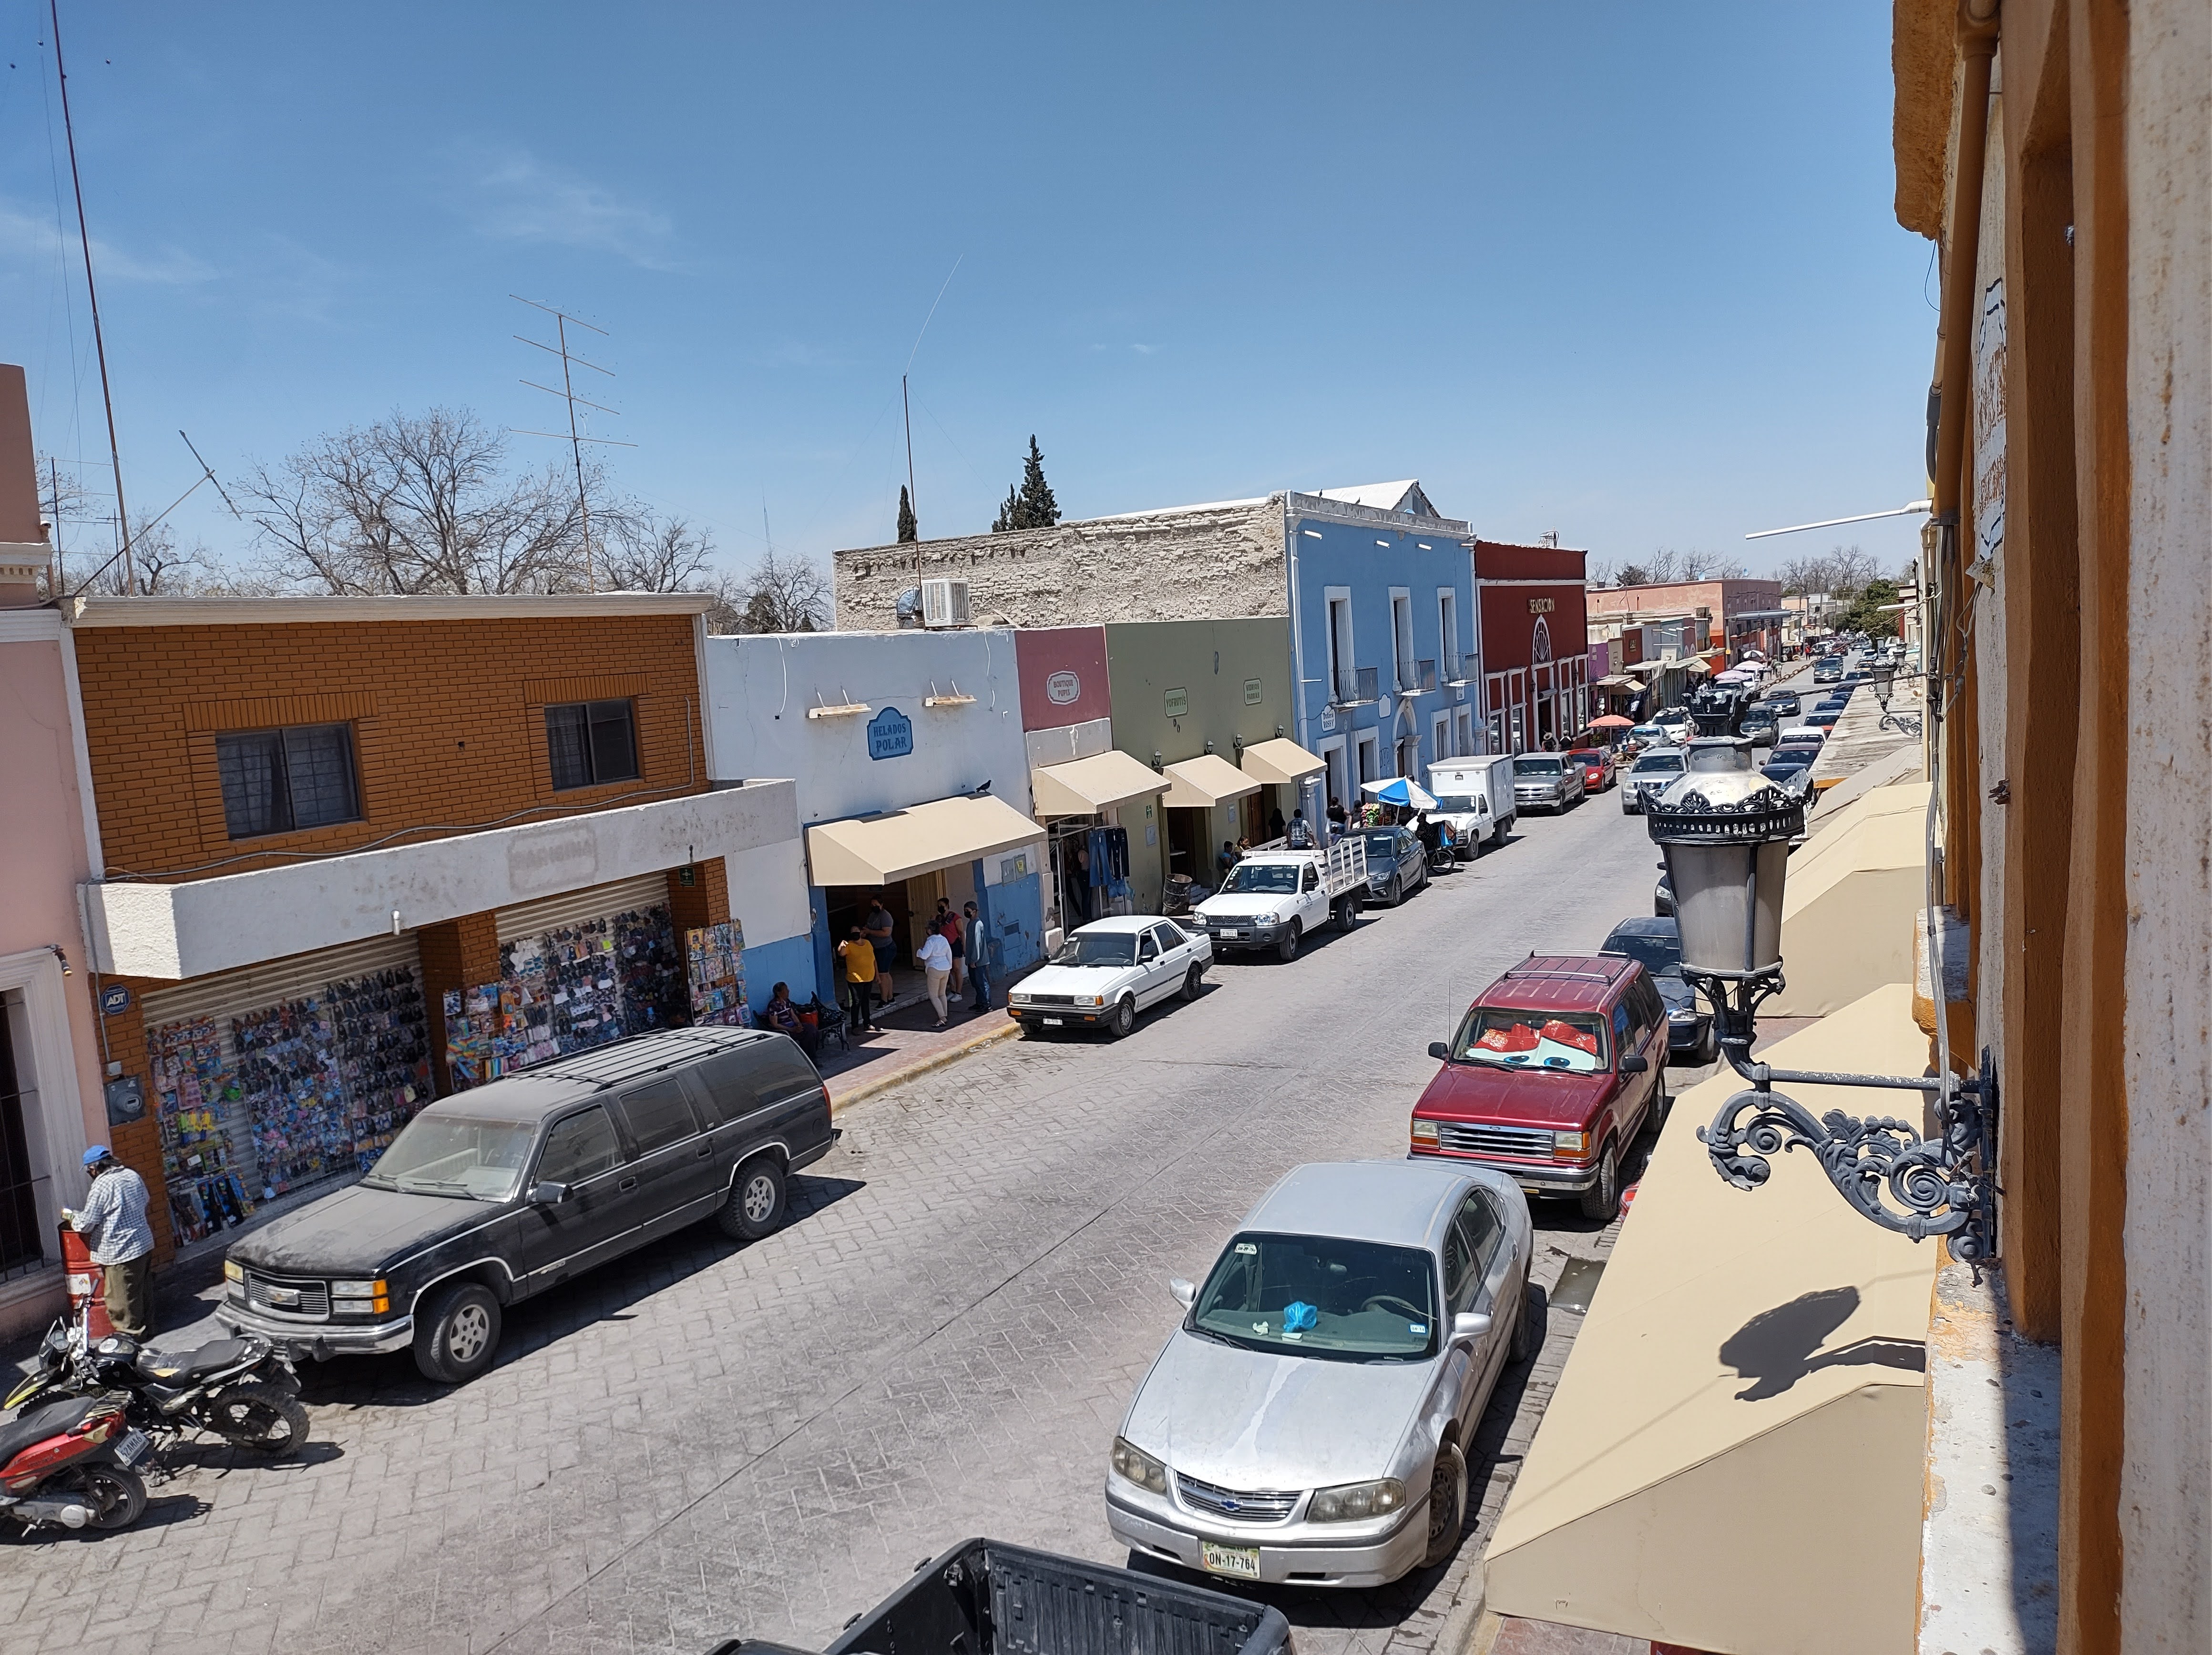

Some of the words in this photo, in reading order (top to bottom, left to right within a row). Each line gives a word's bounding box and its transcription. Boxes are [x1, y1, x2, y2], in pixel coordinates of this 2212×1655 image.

[1530, 597, 1555, 613] SENSACION
[1053, 679, 1073, 688] BOUTIQUE
[1246, 683, 1259, 691] VIDRIOS
[873, 723, 906, 737] HELADOS
[876, 736, 907, 753] POLAR
[107, 993, 124, 1007] ADT
[1209, 1552, 1256, 1572] ON-17-764
